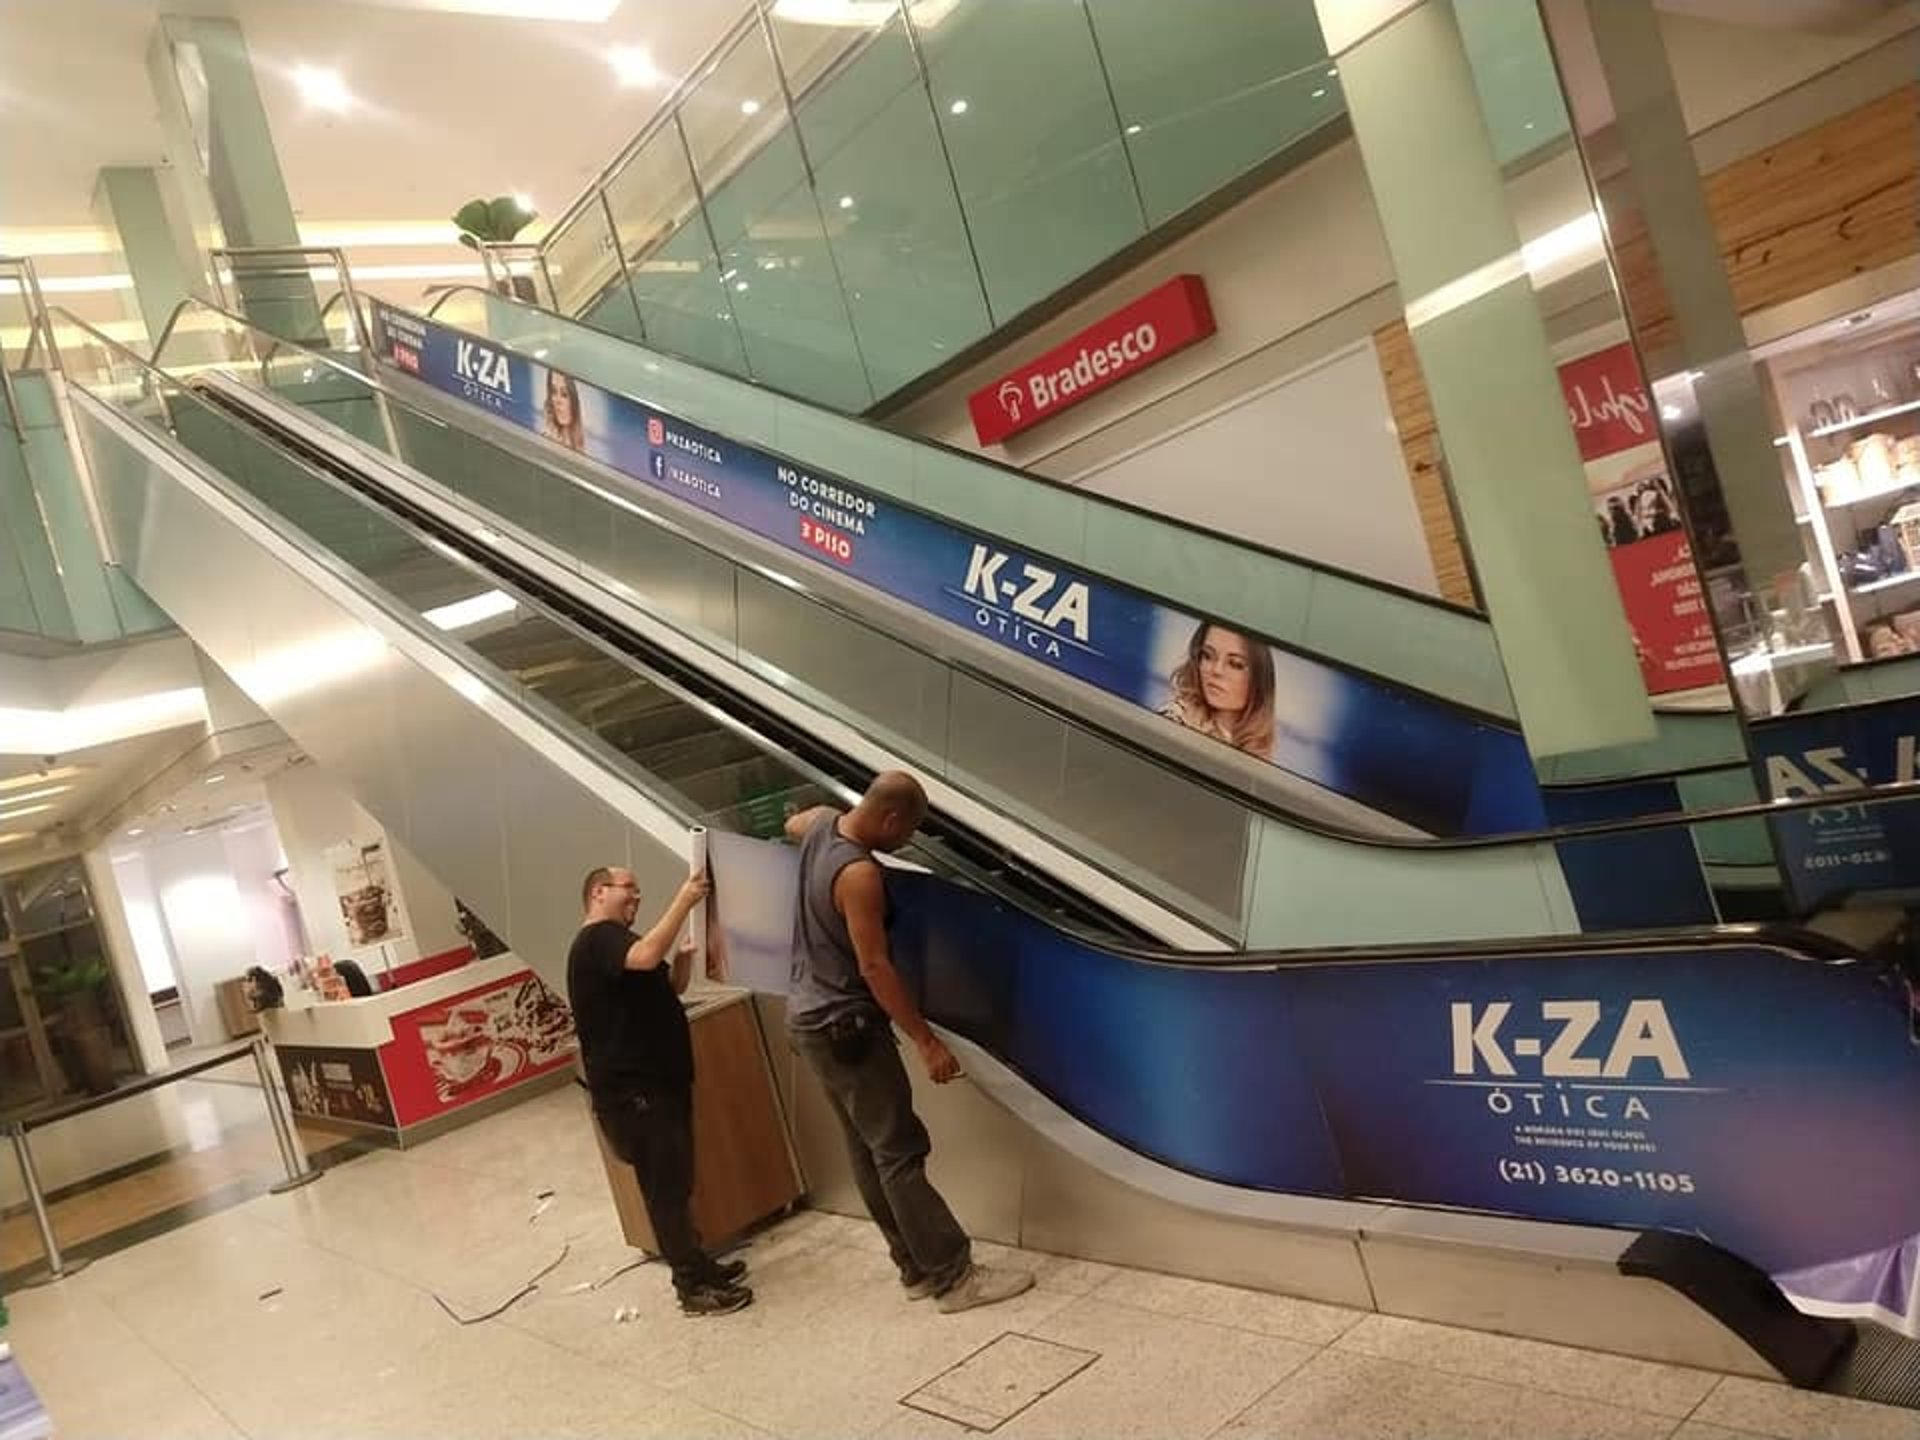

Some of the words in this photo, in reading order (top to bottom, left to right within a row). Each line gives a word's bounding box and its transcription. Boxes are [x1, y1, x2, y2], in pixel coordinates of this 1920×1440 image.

[456, 338, 511, 395] K-ZA
[1028, 323, 1158, 411] Bradesco
[777, 465, 797, 486] NO
[801, 475, 876, 519] CORREDOR
[788, 490, 809, 511] DO
[813, 500, 865, 536] CINEMA
[963, 543, 1090, 642] K-ZA
[1451, 998, 1691, 1080] K-ZA
[1499, 1157, 1546, 1185] (21)
[1554, 1165, 1696, 1194] 3620-1105
